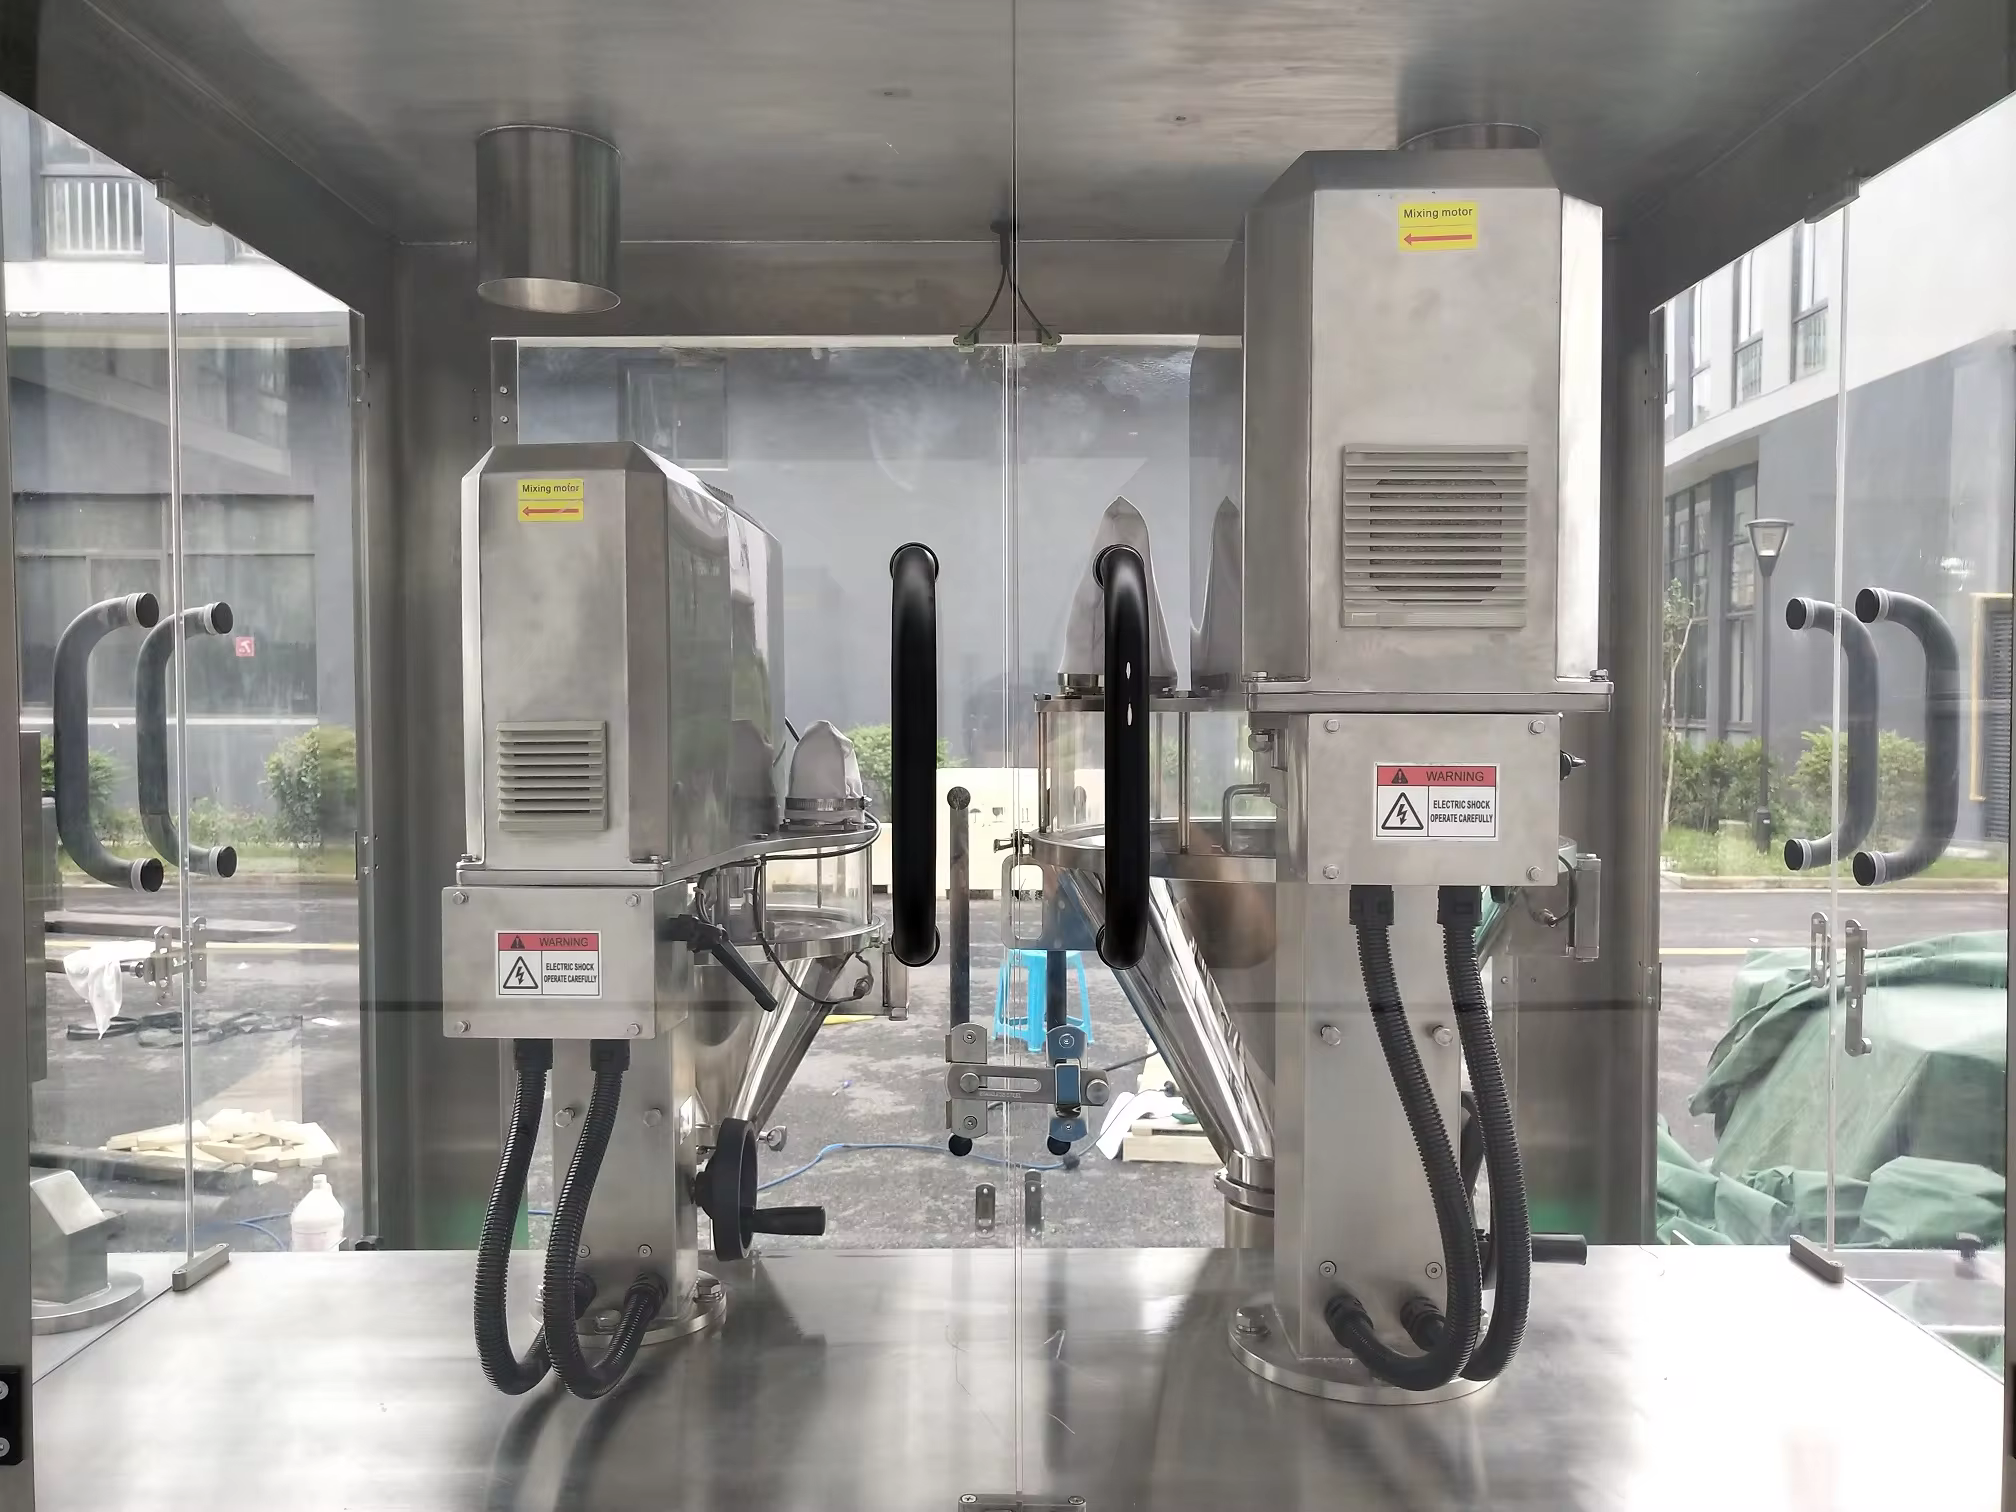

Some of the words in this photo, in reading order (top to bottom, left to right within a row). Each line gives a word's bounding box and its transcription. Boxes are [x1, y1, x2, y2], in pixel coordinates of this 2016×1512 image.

[1404, 208, 1438, 219] Mixing
[1442, 208, 1472, 216] motor
[523, 484, 551, 494] Mixing
[554, 483, 580, 492] motor
[1426, 771, 1484, 782] WARNING
[1434, 800, 1466, 809] ELECTRIC
[1467, 800, 1490, 809] SHOCK
[1430, 814, 1458, 822] OPERATE
[1459, 814, 1493, 822] CAREFULLY
[539, 938, 588, 946] WARNING
